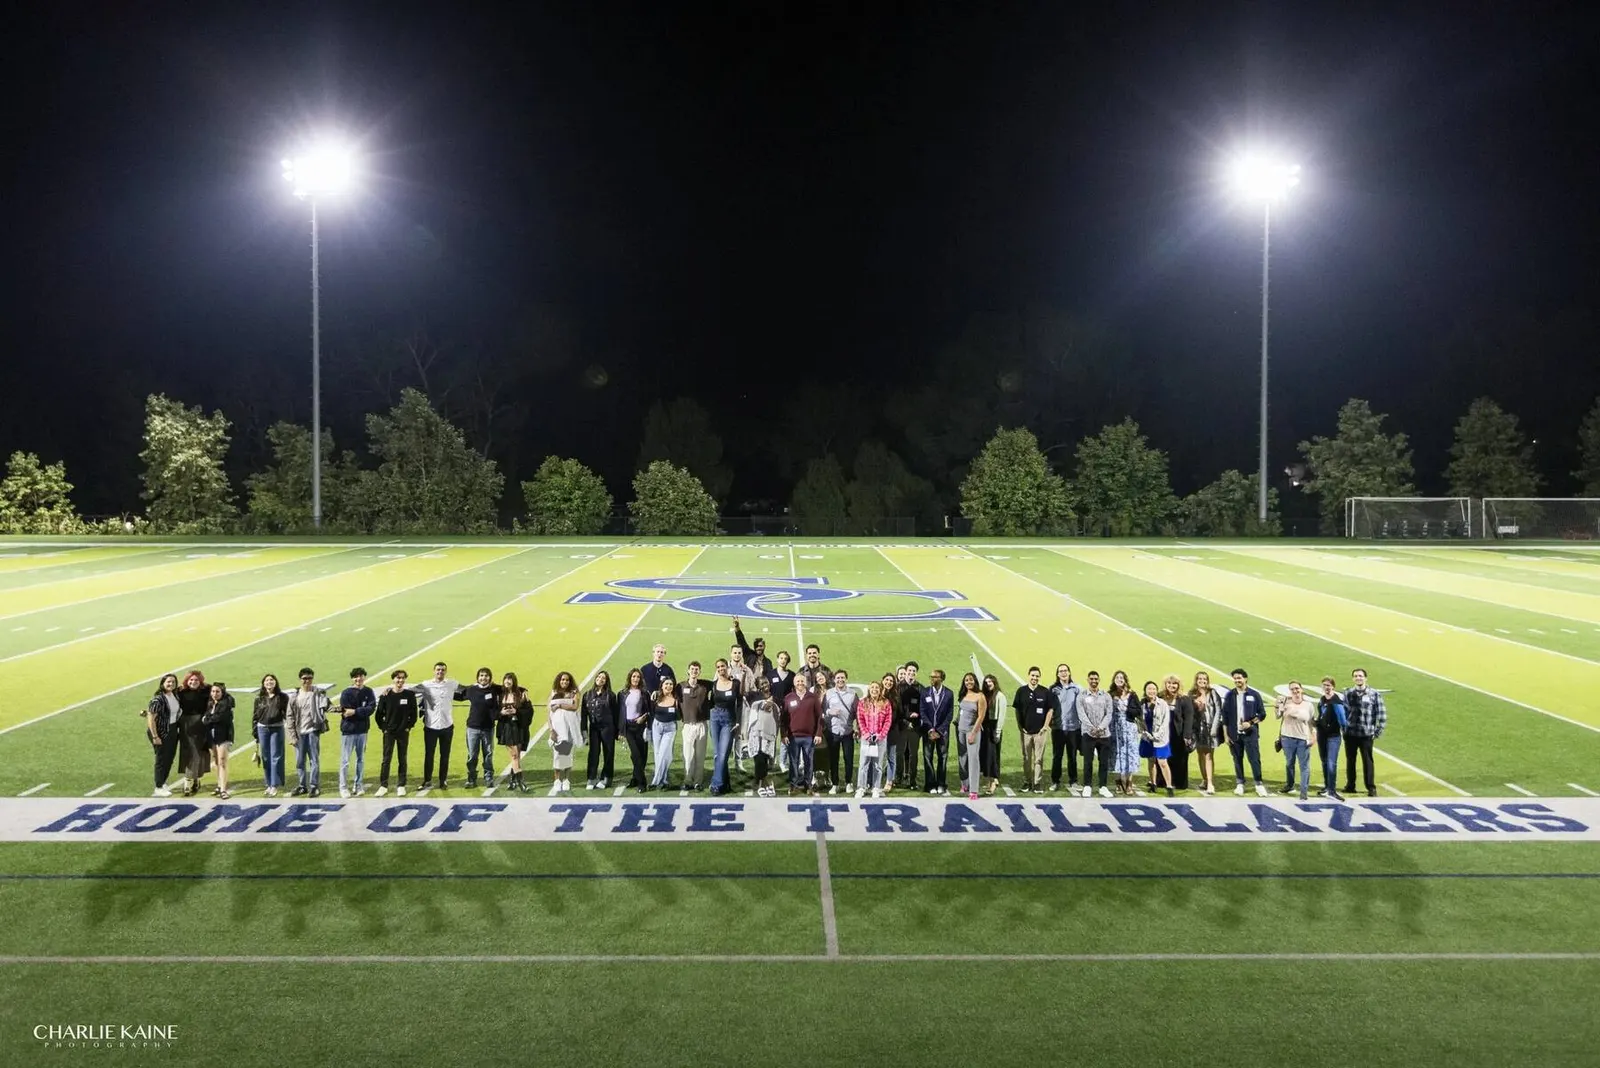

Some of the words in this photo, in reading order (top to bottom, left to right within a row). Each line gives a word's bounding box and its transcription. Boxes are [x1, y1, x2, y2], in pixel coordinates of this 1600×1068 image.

[34, 803, 342, 833] HOME
[367, 803, 506, 833] OF
[548, 803, 745, 833] THE
[787, 803, 1590, 834] TRAILBLAZERS
